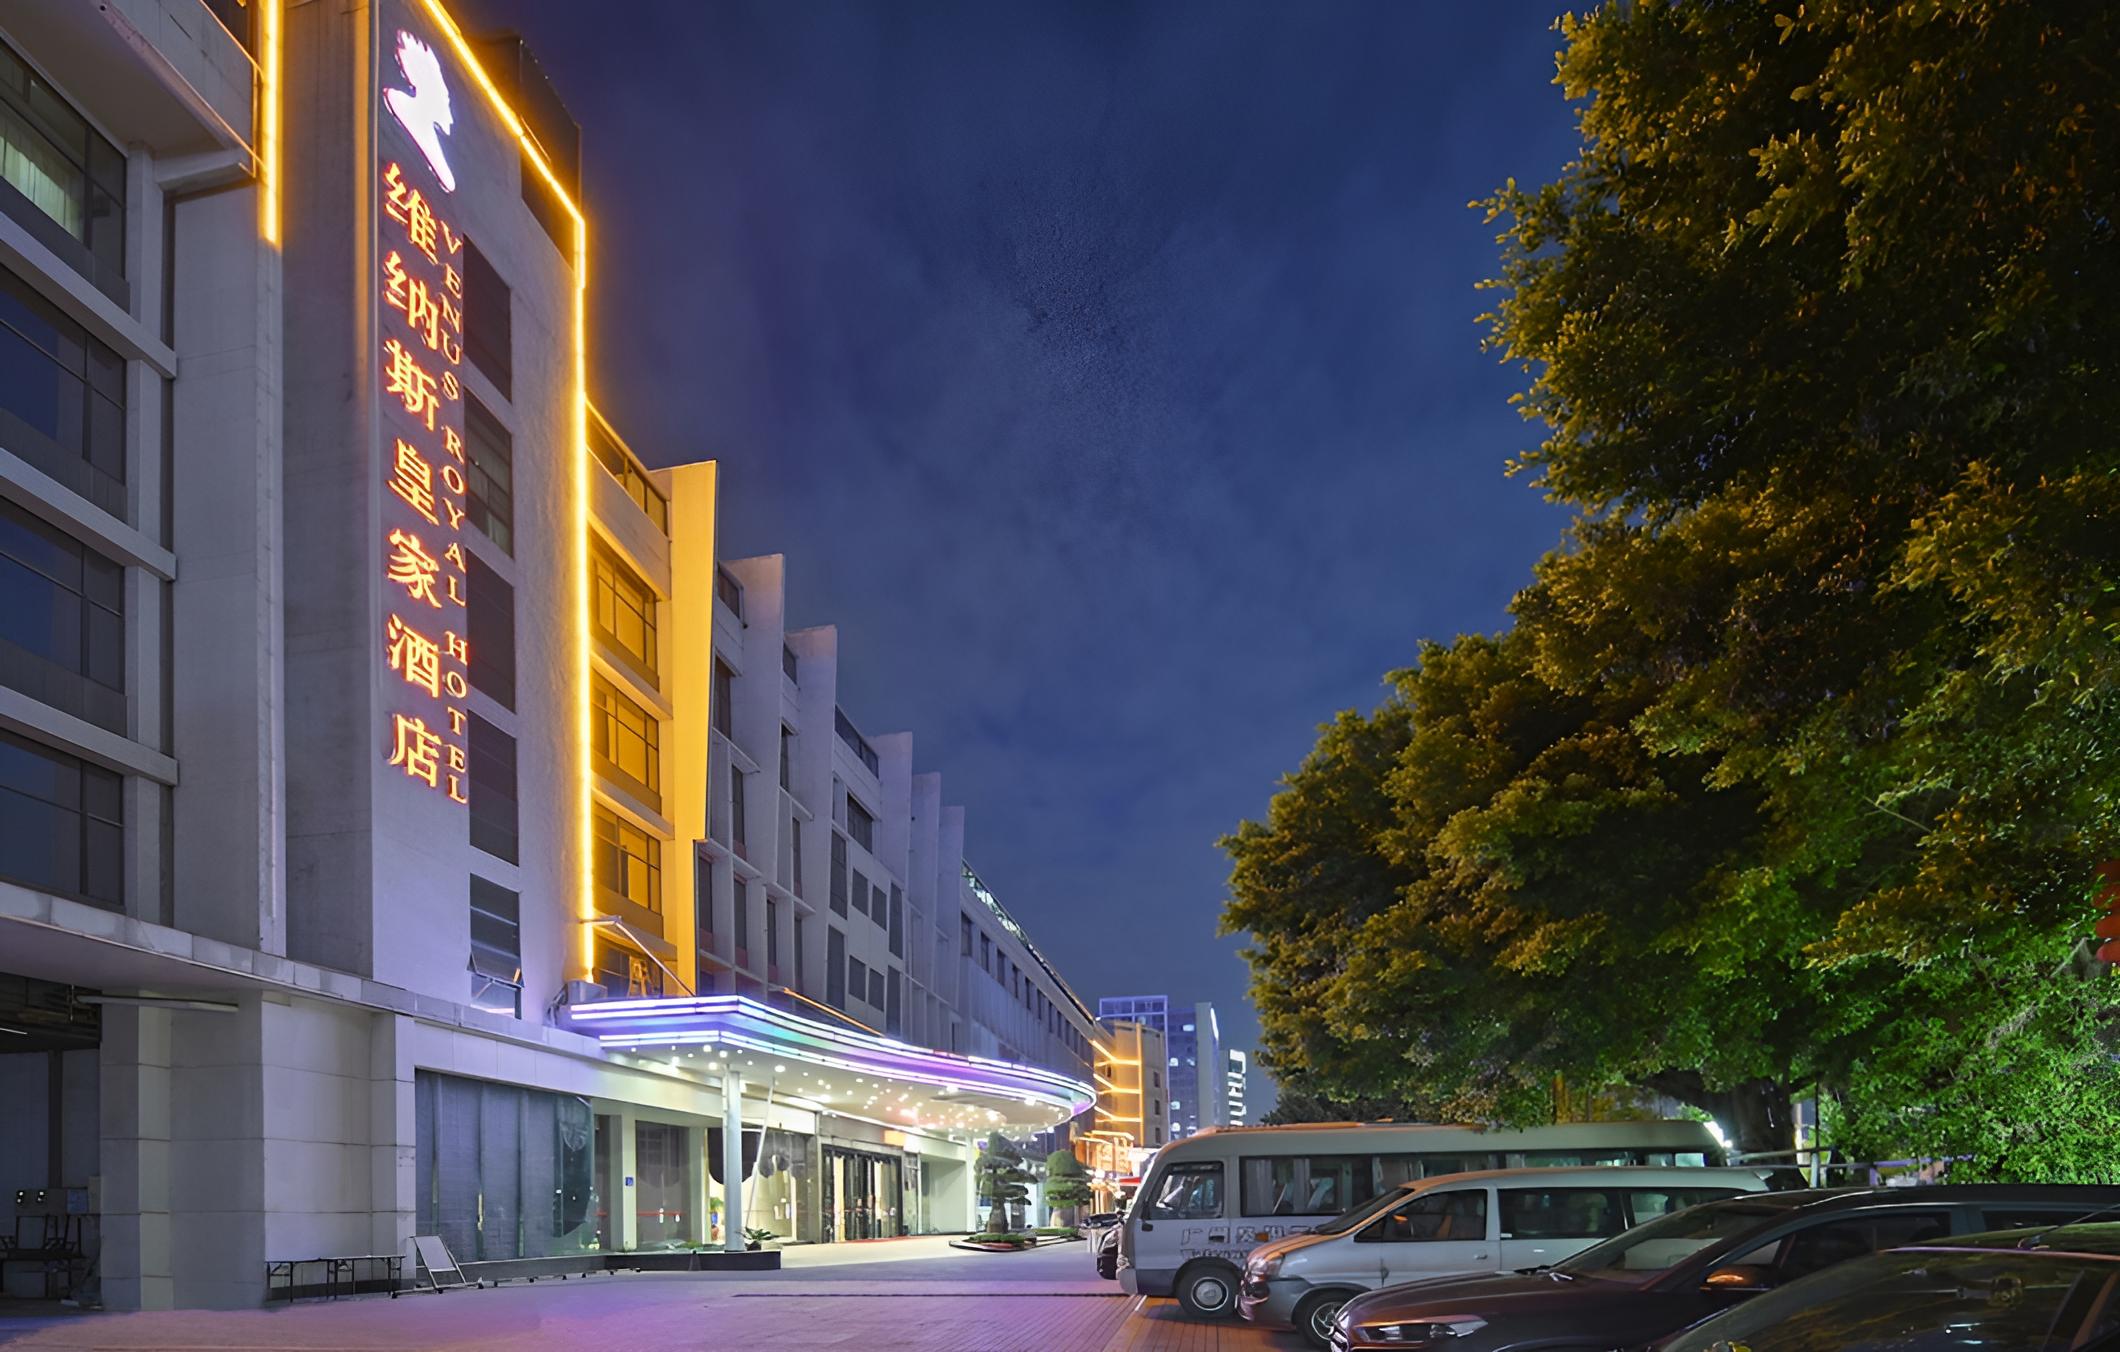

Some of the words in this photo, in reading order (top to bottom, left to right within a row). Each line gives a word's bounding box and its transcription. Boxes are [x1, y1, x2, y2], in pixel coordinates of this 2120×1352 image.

[440, 220, 462, 400] VENUS
[383, 162, 442, 788] 维纳斯皇家酒店
[441, 424, 466, 607] ROYAL
[444, 630, 468, 804] HOTEL
